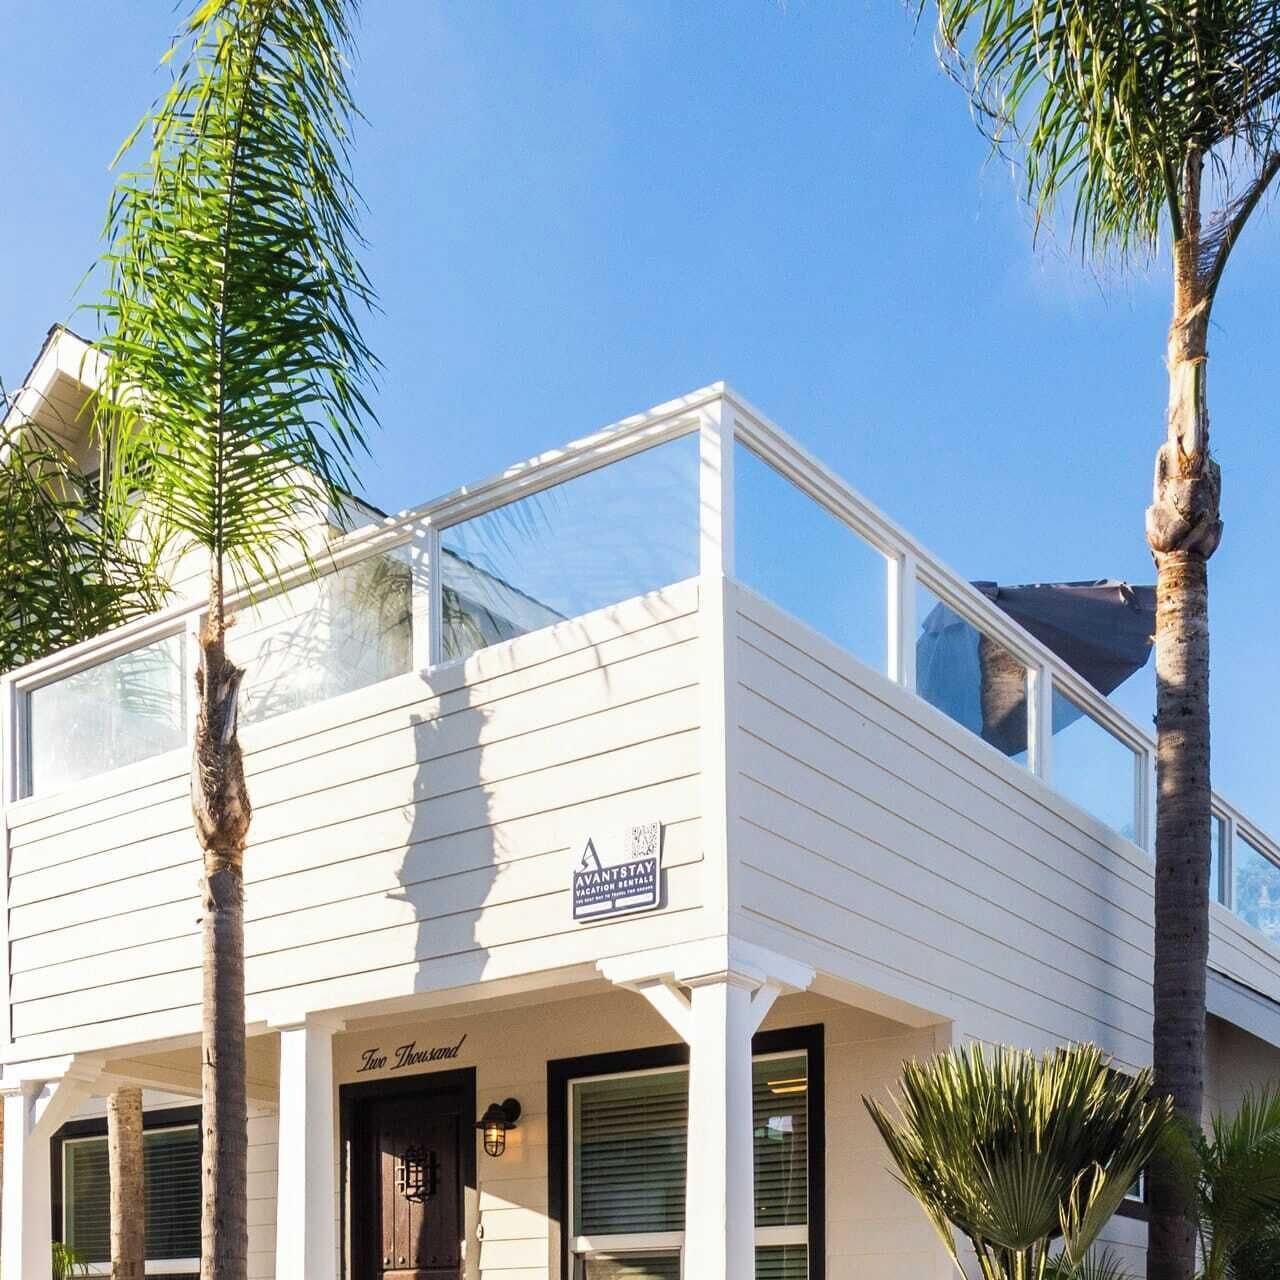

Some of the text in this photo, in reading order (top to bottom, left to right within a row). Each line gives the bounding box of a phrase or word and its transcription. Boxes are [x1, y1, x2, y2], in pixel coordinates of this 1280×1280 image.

[575, 861, 654, 888] AVANTSTAY
[575, 884, 615, 897] VACATION
[619, 875, 654, 888] RENTALS
[356, 1033, 467, 1073] Two Thousand
